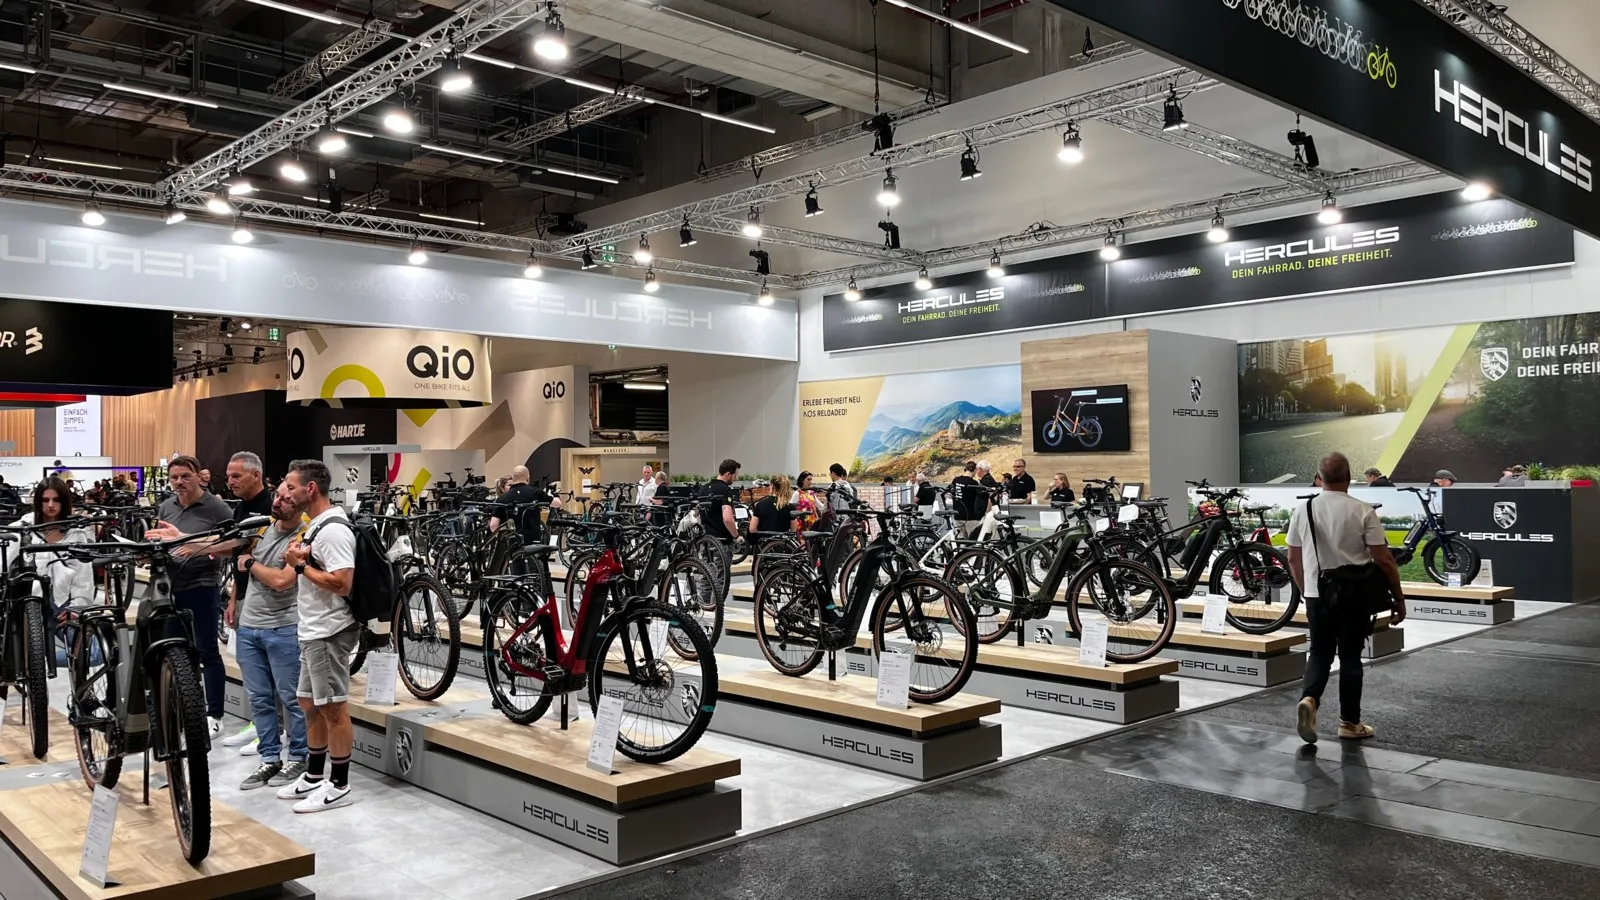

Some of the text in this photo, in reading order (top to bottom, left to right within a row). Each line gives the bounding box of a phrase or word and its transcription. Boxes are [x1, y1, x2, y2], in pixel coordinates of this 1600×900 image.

[1433, 69, 1592, 192] HERCULES
[1224, 226, 1399, 266] HERCULES
[1232, 249, 1393, 279] DEIN FAHRRAD. DEINE FREIHEIT.
[898, 286, 1004, 313] HERCULES
[902, 304, 1000, 324] DEIN FAHRRAD. DEINE FREIHEIT.
[1522, 342, 1599, 359] DEIN FAHR
[406, 345, 475, 381] QiO
[1517, 364, 1560, 378] DEINE
[543, 381, 565, 399] QiO
[823, 397, 847, 405] FREIHEIT
[64, 416, 85, 424] SIMPEL
[817, 409, 848, 417] RELOADED!
[1172, 408, 1219, 418] HERCULES
[337, 423, 366, 439] HARTJE
[1459, 531, 1554, 543] HERCULES
[1413, 606, 1487, 618] HERCULES
[1026, 689, 1115, 711] HERCULES
[822, 734, 913, 764] HERCULES
[523, 801, 609, 845] HERCULES
